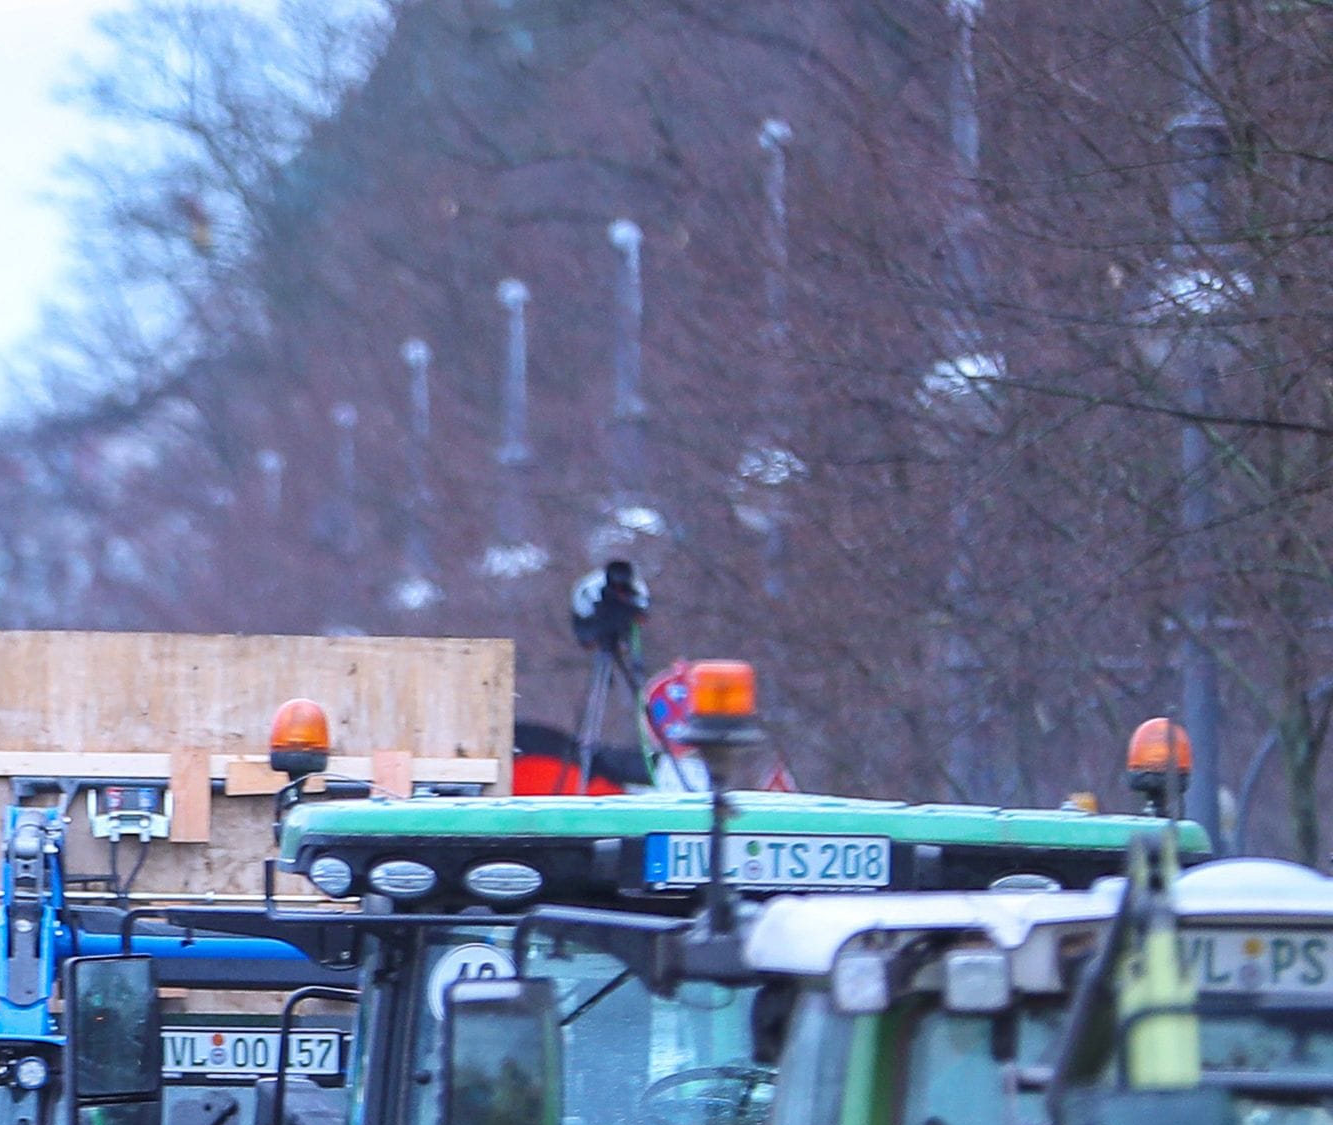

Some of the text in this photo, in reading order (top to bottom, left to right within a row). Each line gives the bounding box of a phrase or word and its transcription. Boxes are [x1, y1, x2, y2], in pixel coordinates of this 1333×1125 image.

[766, 841, 810, 879] TS
[819, 842, 883, 880] 208
[1269, 937, 1327, 986] PS
[162, 1036, 206, 1067] VL
